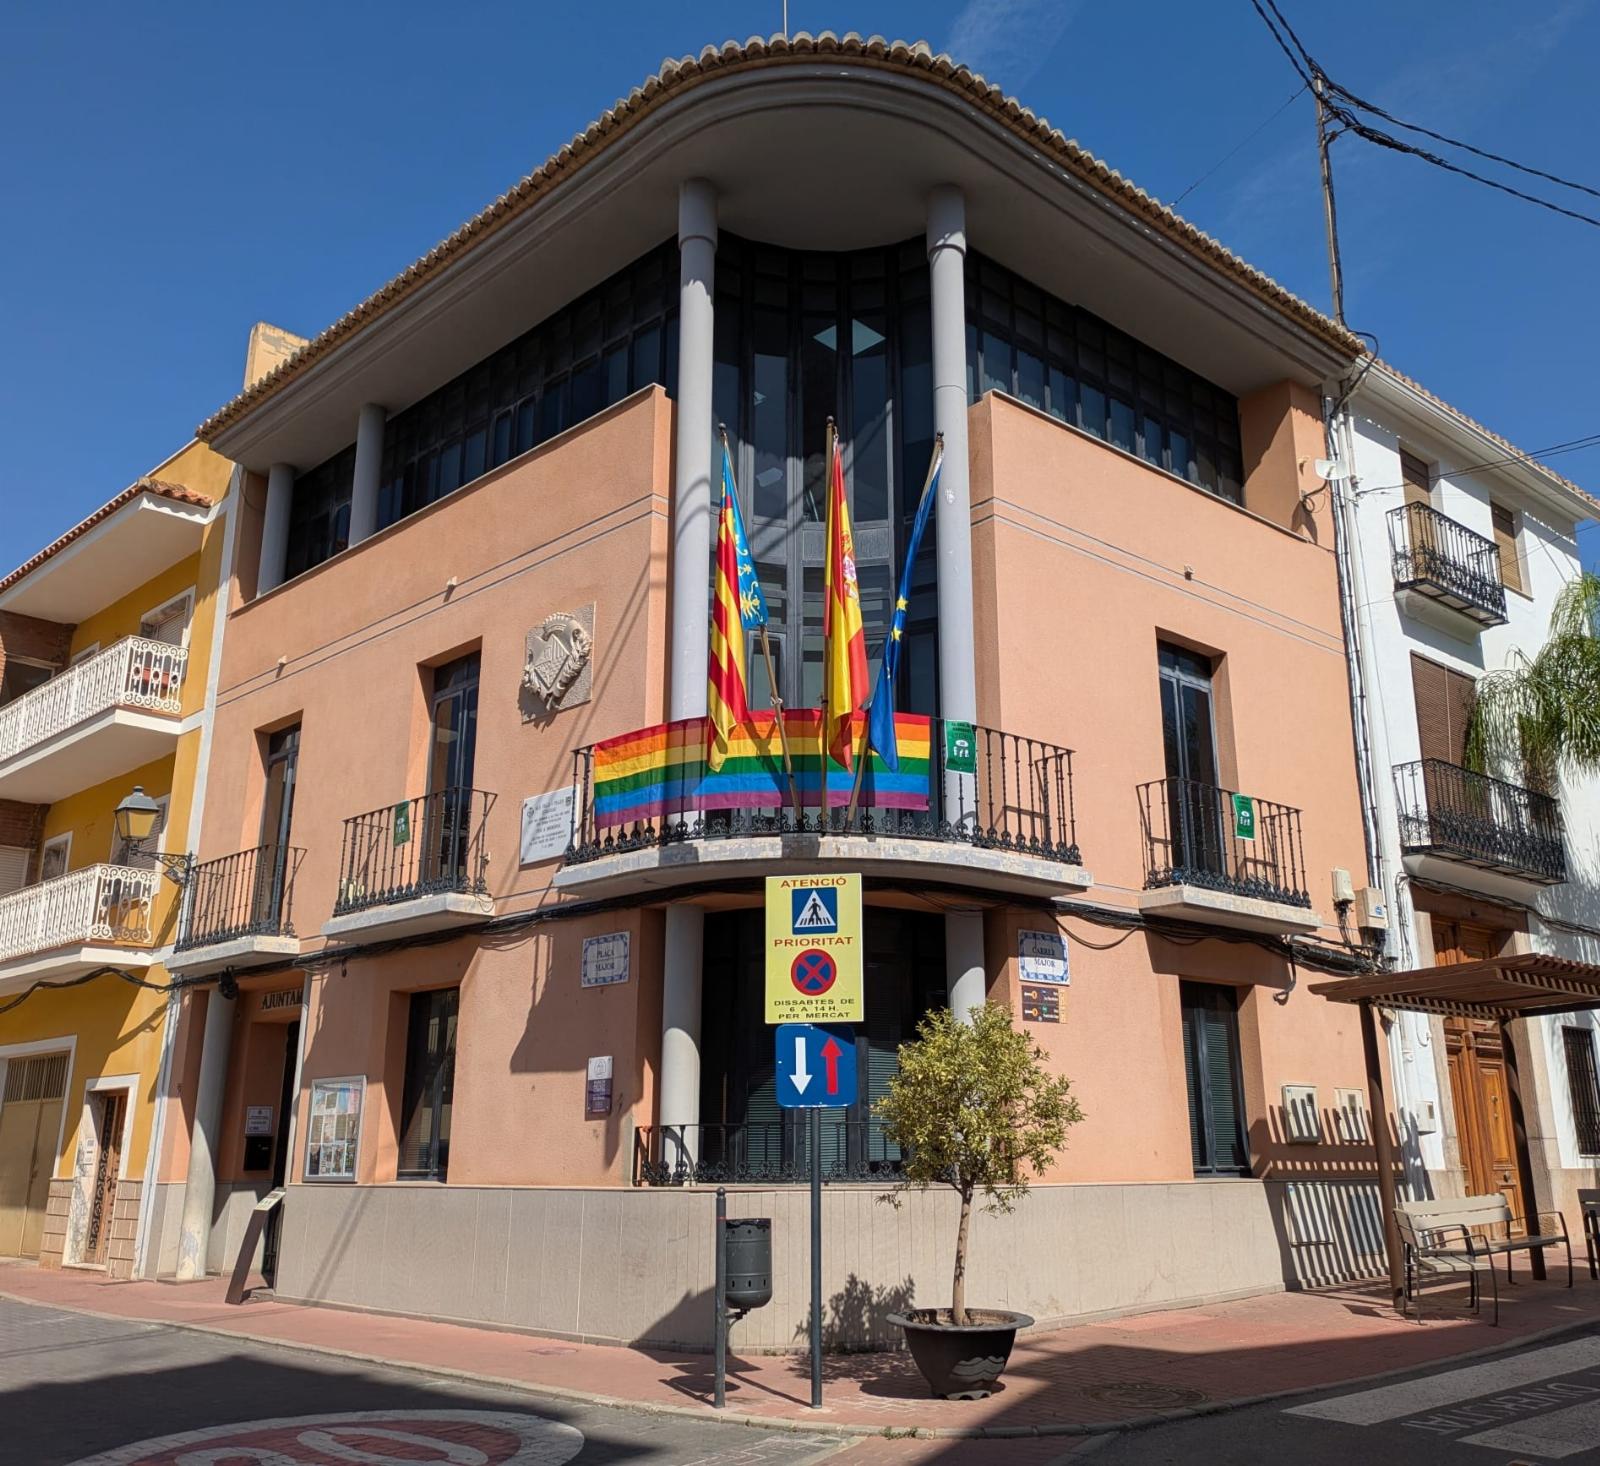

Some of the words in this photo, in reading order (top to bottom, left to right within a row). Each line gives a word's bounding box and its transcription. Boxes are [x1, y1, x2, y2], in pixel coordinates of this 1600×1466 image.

[780, 876, 847, 888] ATENCIÓ
[774, 937, 853, 947] PRIORITAT
[1034, 958, 1056, 968] MAJOR
